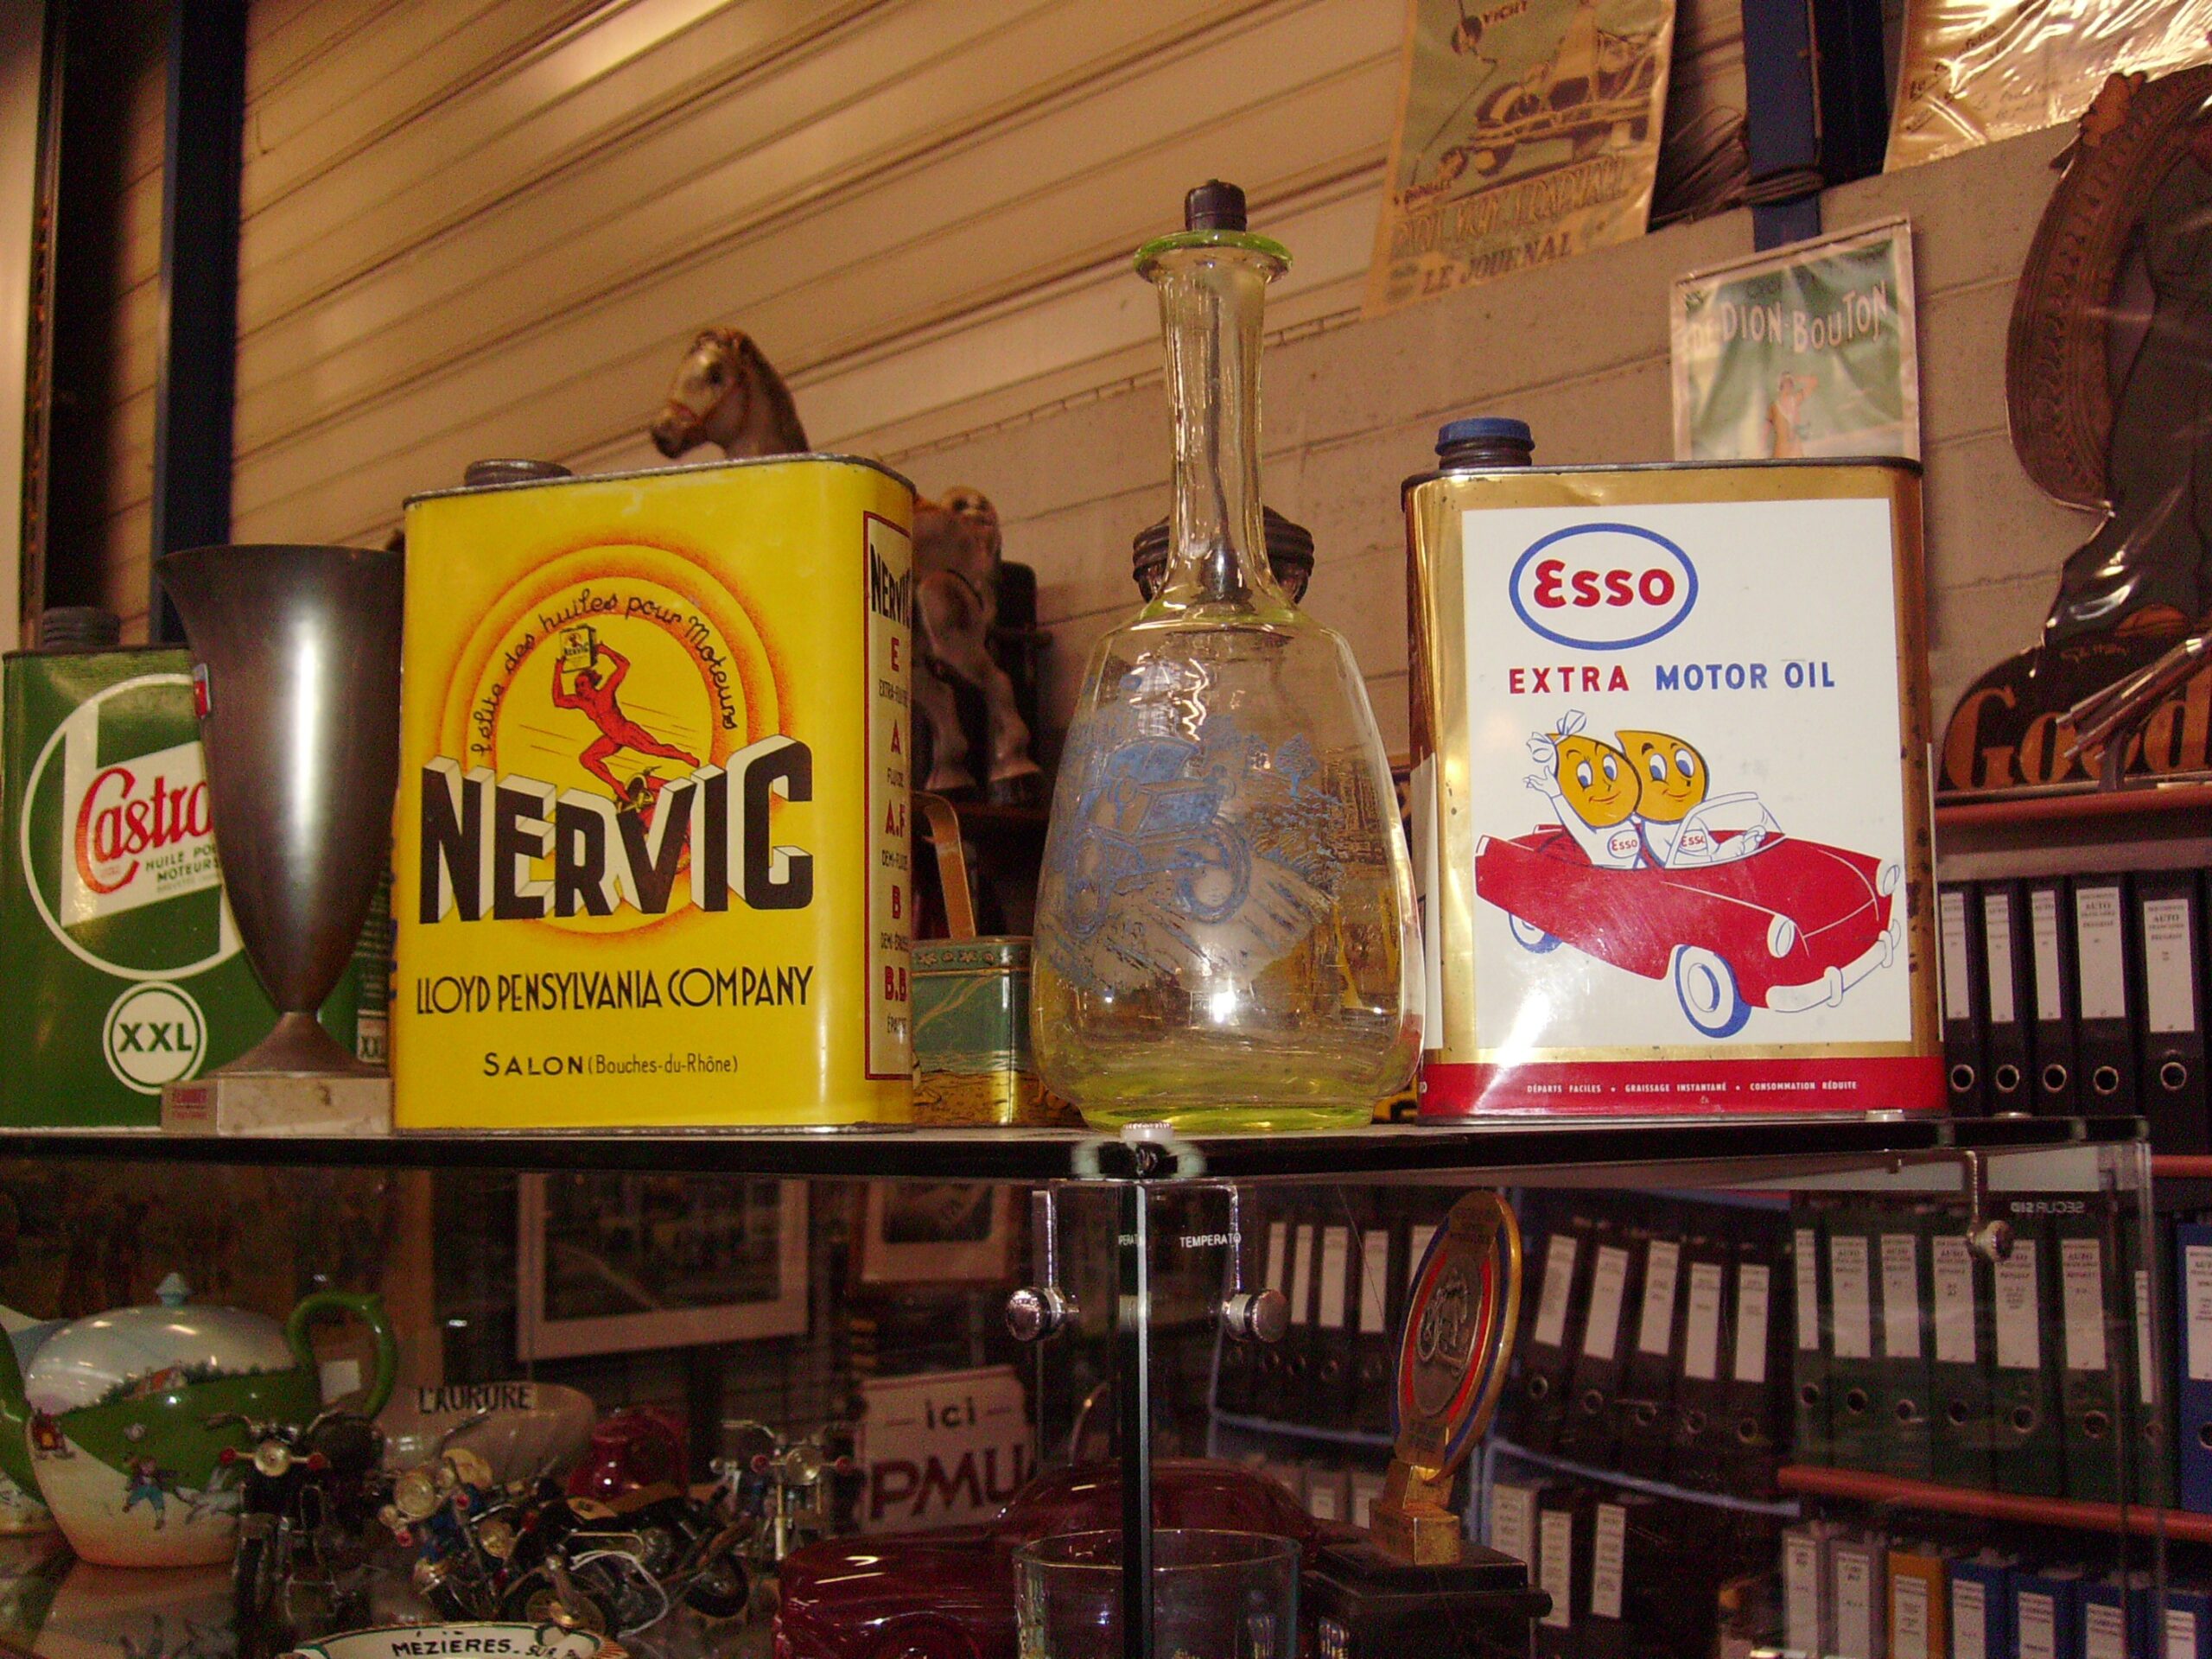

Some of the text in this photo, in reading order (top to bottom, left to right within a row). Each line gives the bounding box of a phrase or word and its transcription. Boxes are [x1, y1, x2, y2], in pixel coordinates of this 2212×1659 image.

[538, 588, 618, 632] huiles
[625, 595, 682, 624] pour
[891, 636, 899, 672] E
[1509, 661, 1836, 694] EXTRA MOTOR OIL
[891, 719, 900, 755] A
[74, 766, 214, 894] Castro
[419, 735, 813, 925] NERVIC
[146, 849, 184, 873] HUILE
[892, 885, 901, 919] B
[416, 965, 814, 1014] LLOYD PENSYLVANIA COMPANY
[118, 1020, 194, 1054] XXL
[483, 1052, 740, 1077] SALON (Bouches-du-Rhône)
[1527, 1080, 1857, 1094] DÉPARTS FACILES GRAISSAGE INSTANTANÉ CONSOMMATION RÉDUITE
[871, 1443, 1026, 1520] PMU
